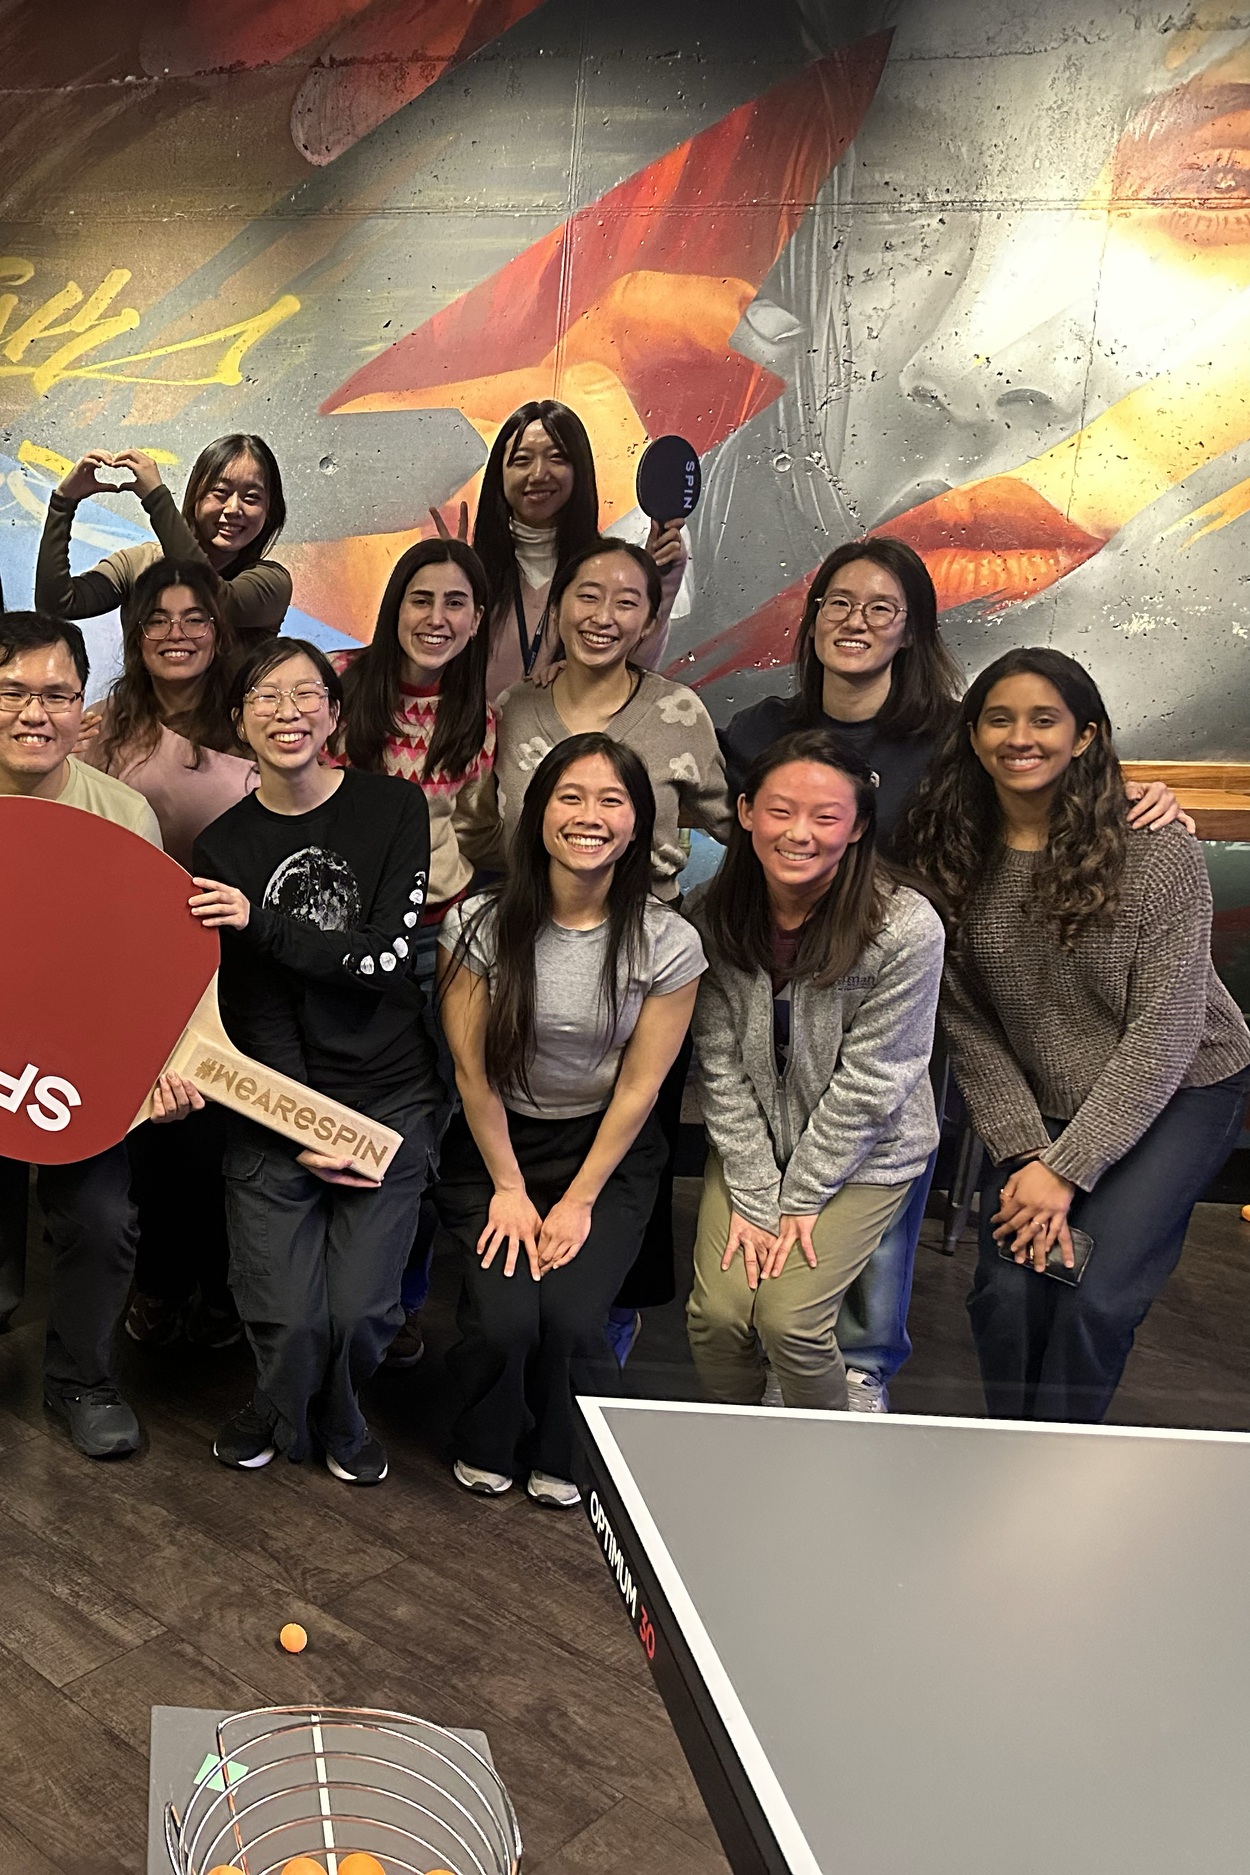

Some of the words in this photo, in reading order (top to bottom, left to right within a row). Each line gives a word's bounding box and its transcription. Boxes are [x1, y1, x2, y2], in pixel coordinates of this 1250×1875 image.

[683, 461, 695, 509] SPIN
[590, 1490, 638, 1619] OPTIMUM
[639, 1604, 656, 1660] 30
